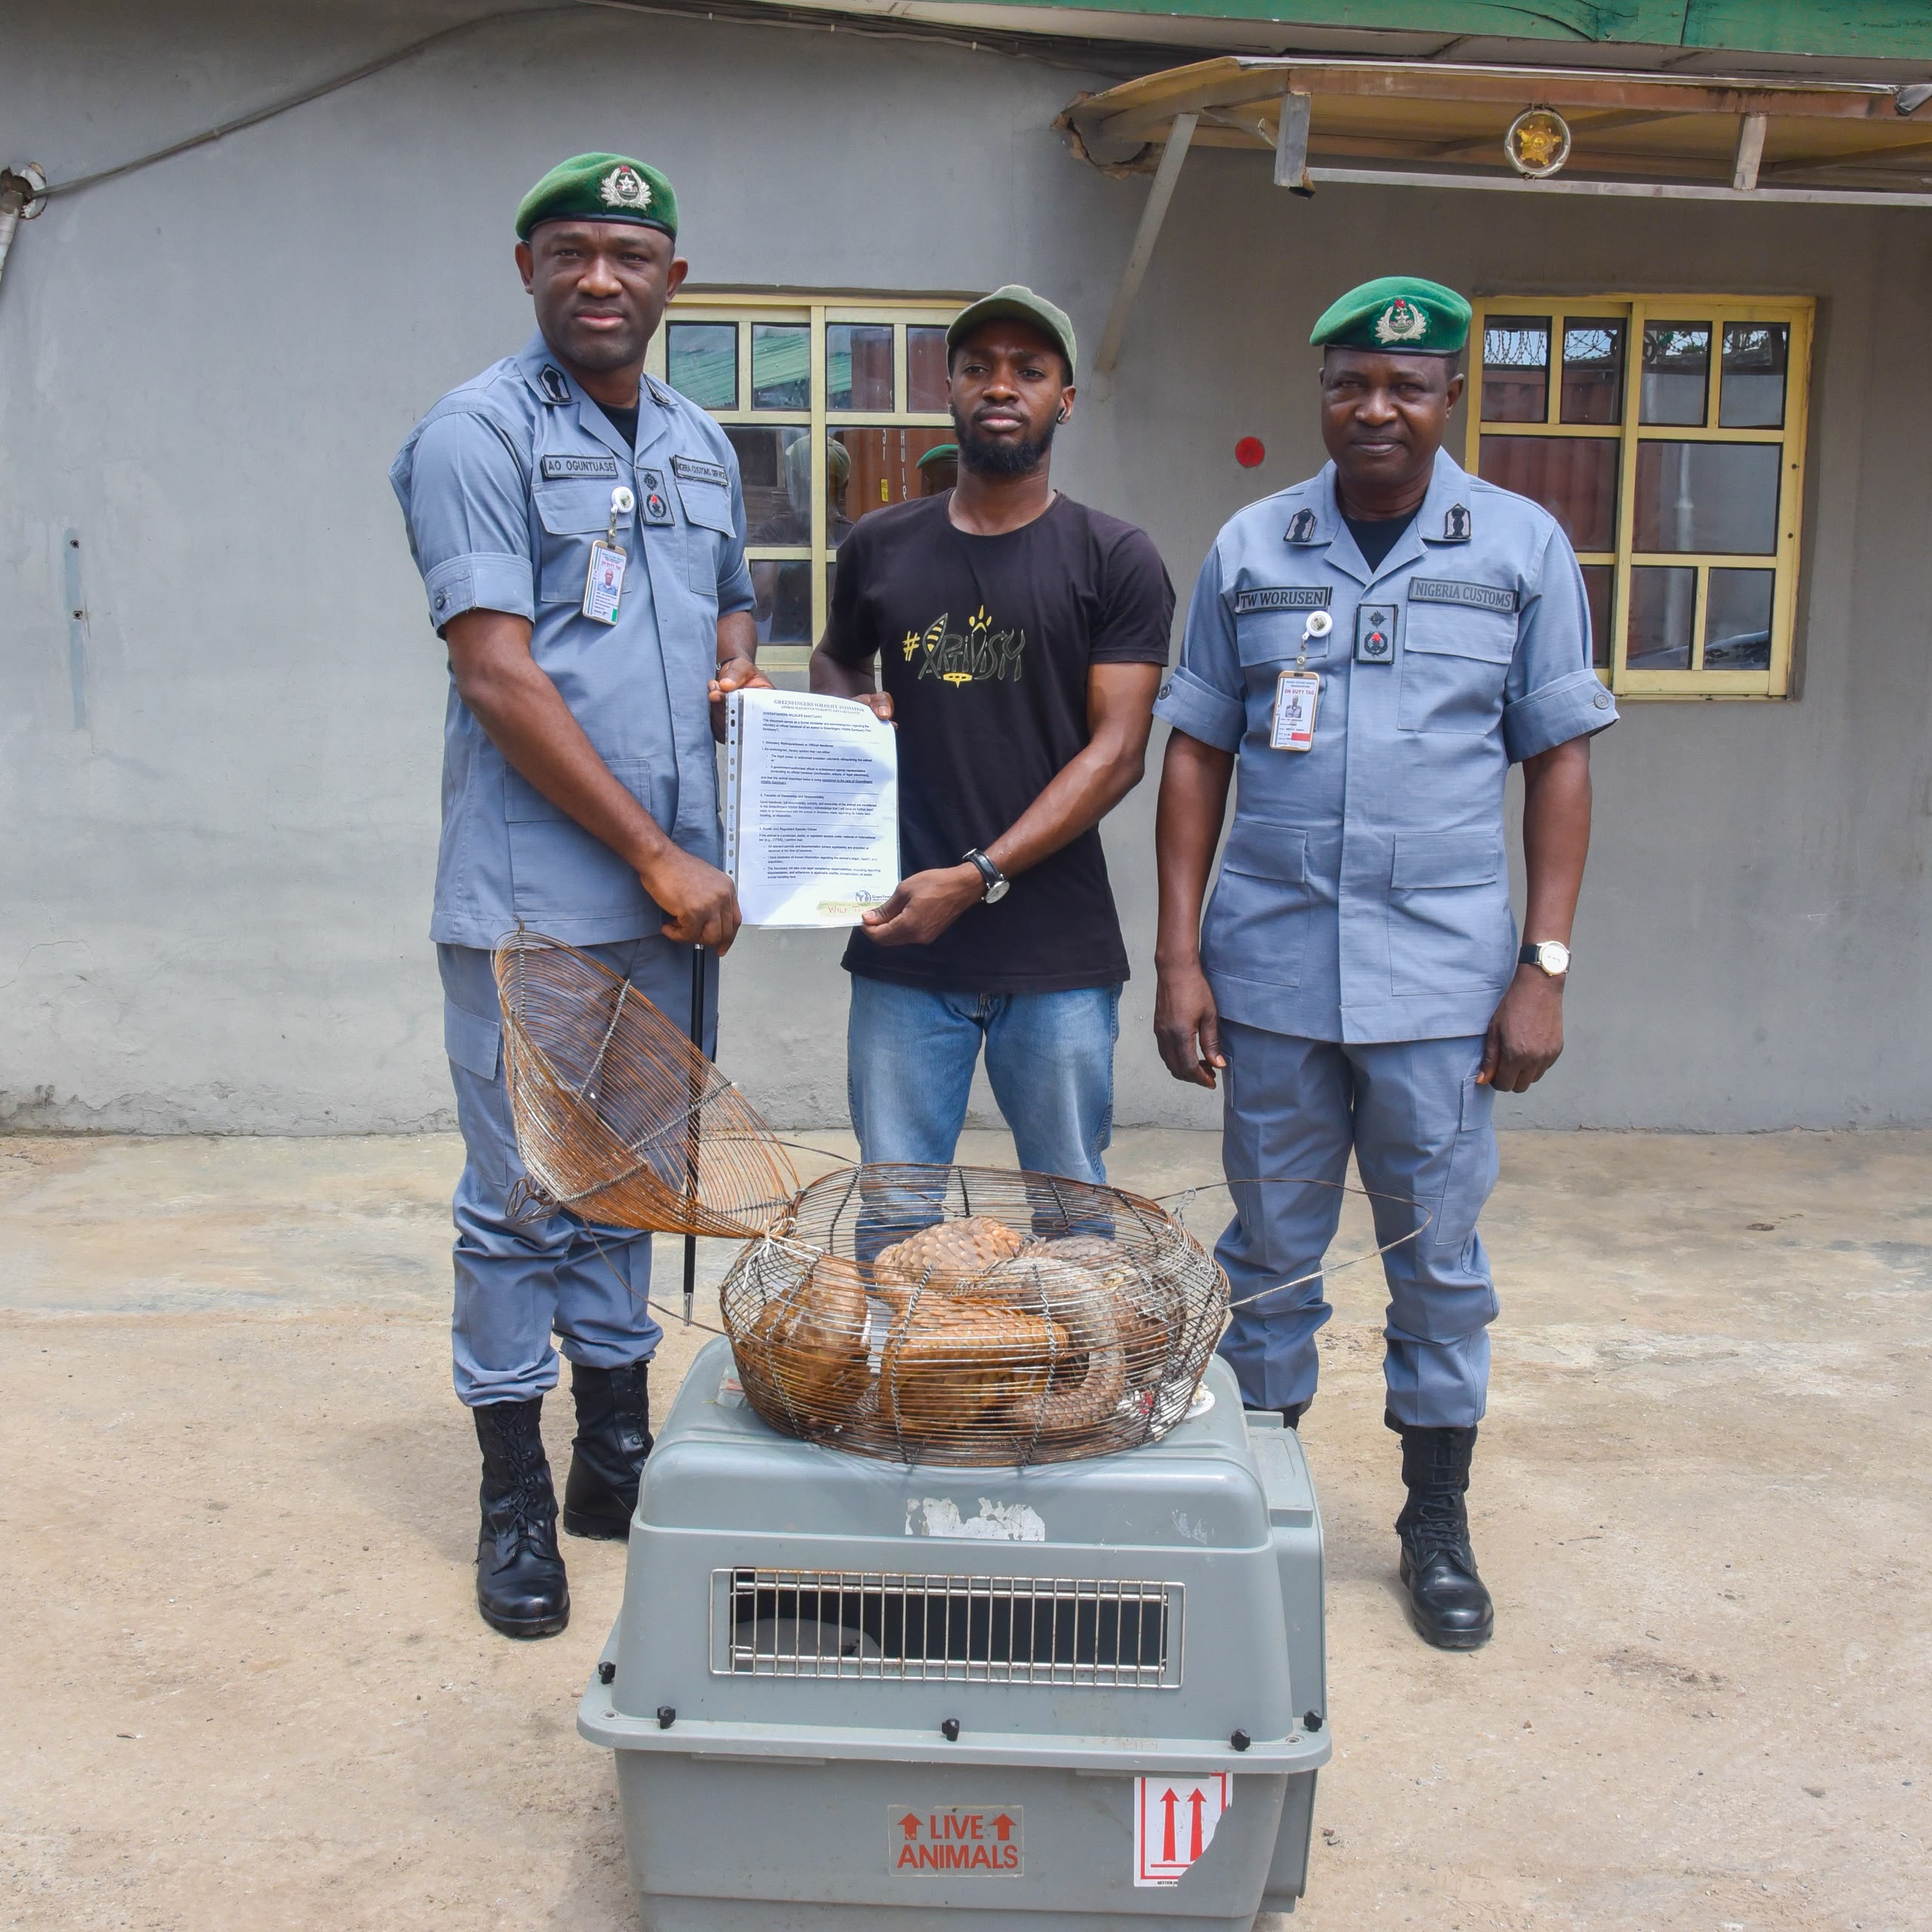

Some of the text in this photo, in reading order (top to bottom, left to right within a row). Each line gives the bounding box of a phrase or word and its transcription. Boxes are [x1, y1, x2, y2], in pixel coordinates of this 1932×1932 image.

[548, 460, 615, 472] AO OGUNTUASE
[1241, 591, 1324, 608] TW WORUSEN
[1415, 583, 1511, 607] NIGERIA CUSTOMS
[930, 1815, 984, 1839] LIVE
[897, 1844, 1018, 1869] ANIMALS
